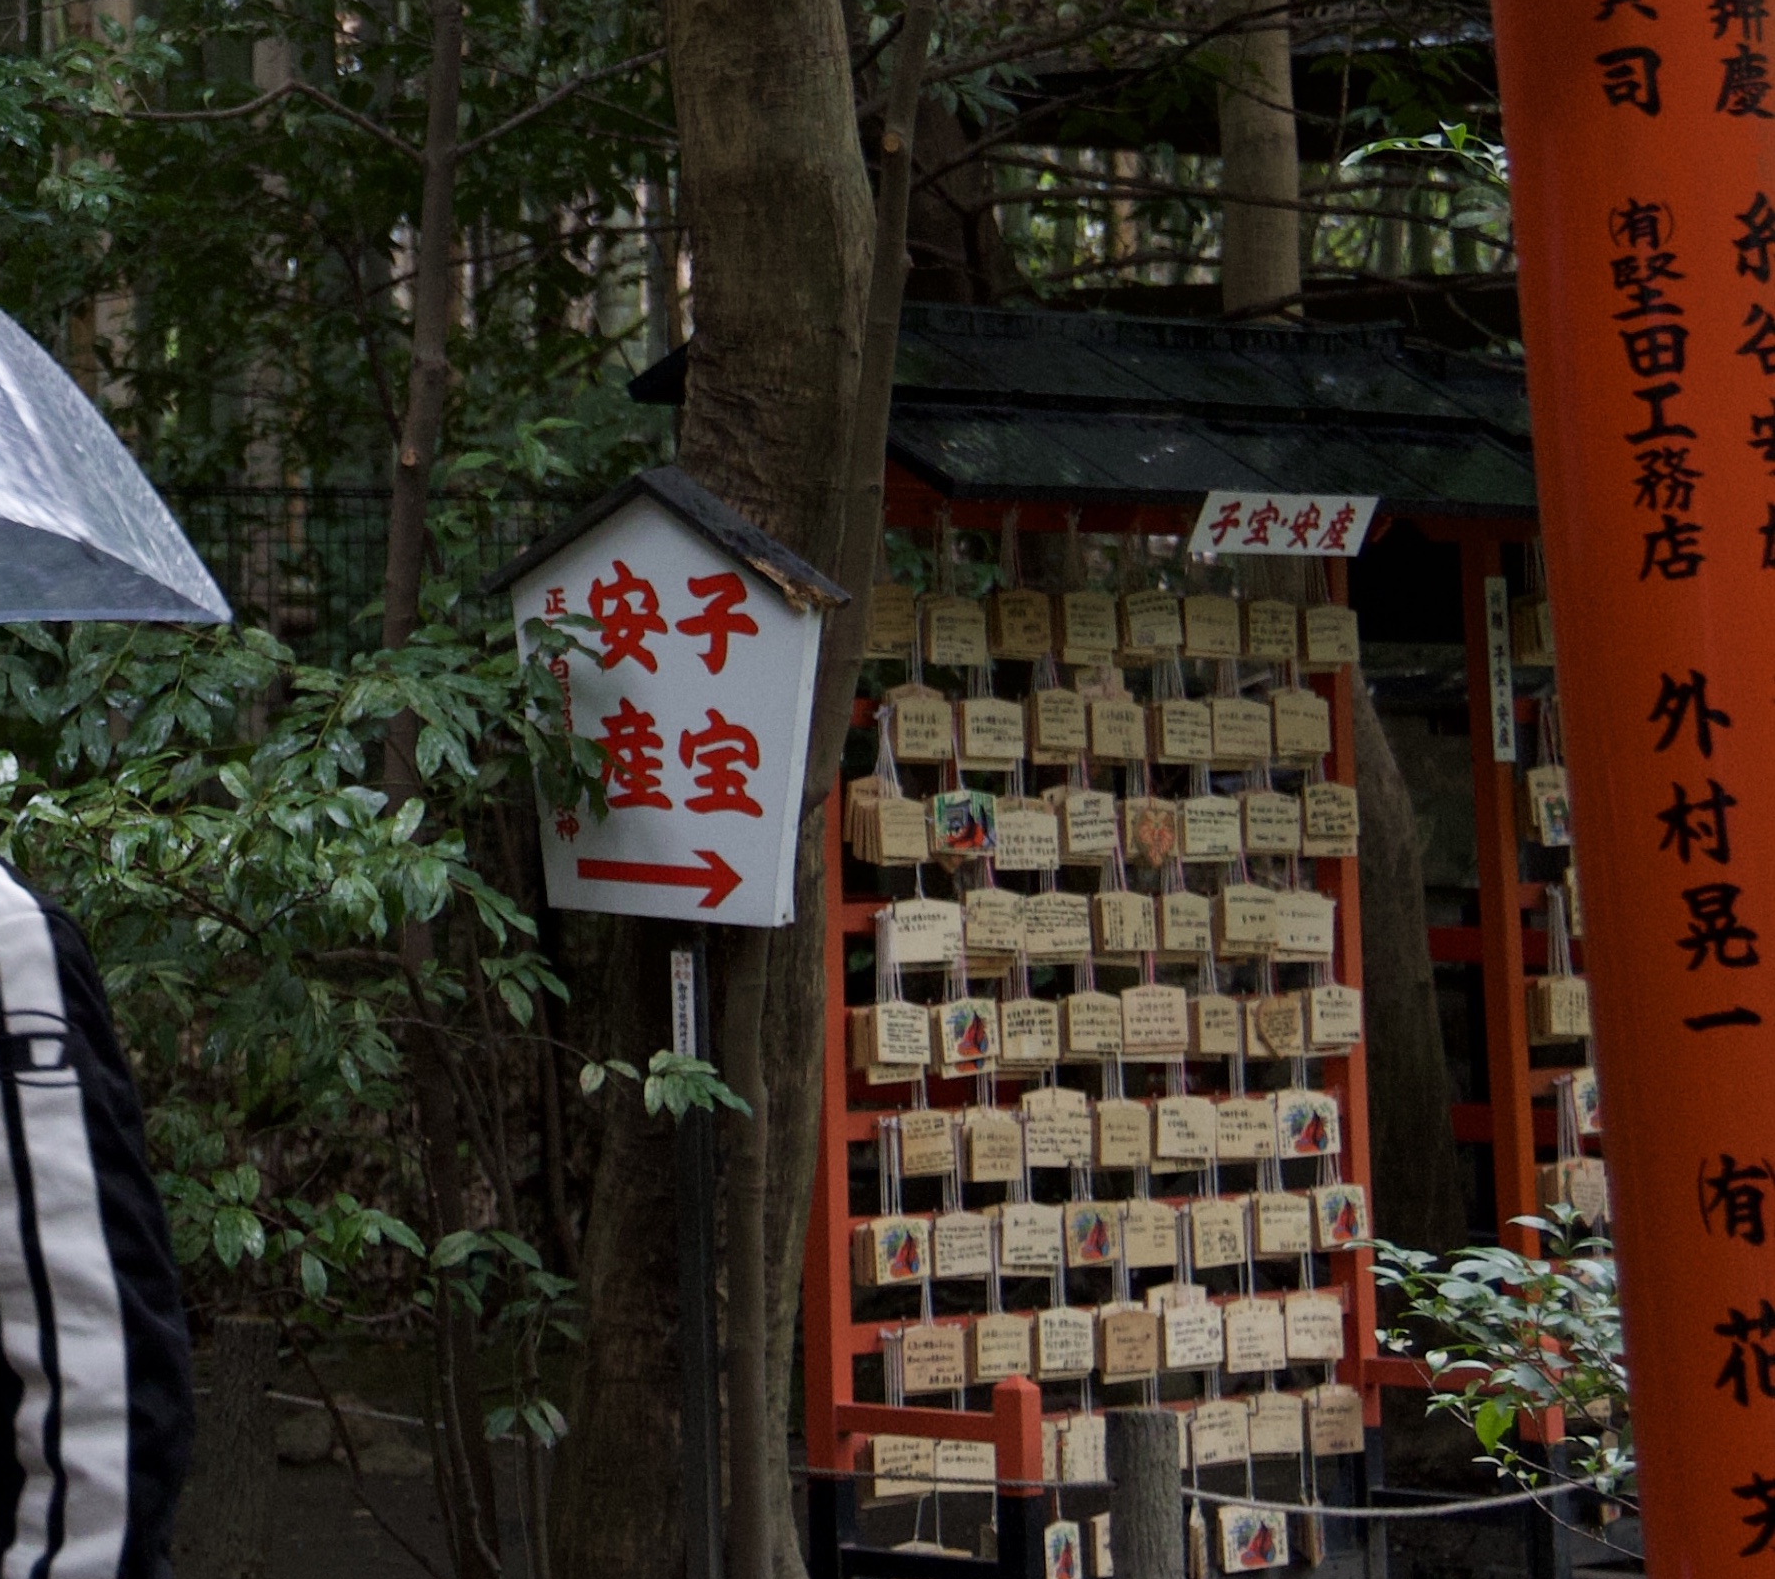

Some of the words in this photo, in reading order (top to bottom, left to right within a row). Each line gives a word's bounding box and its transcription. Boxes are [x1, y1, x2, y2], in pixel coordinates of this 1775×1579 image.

[587, 559, 673, 811] 安産
[675, 571, 764, 818] 子宝
[1648, 669, 1762, 1032] 外村晃一
